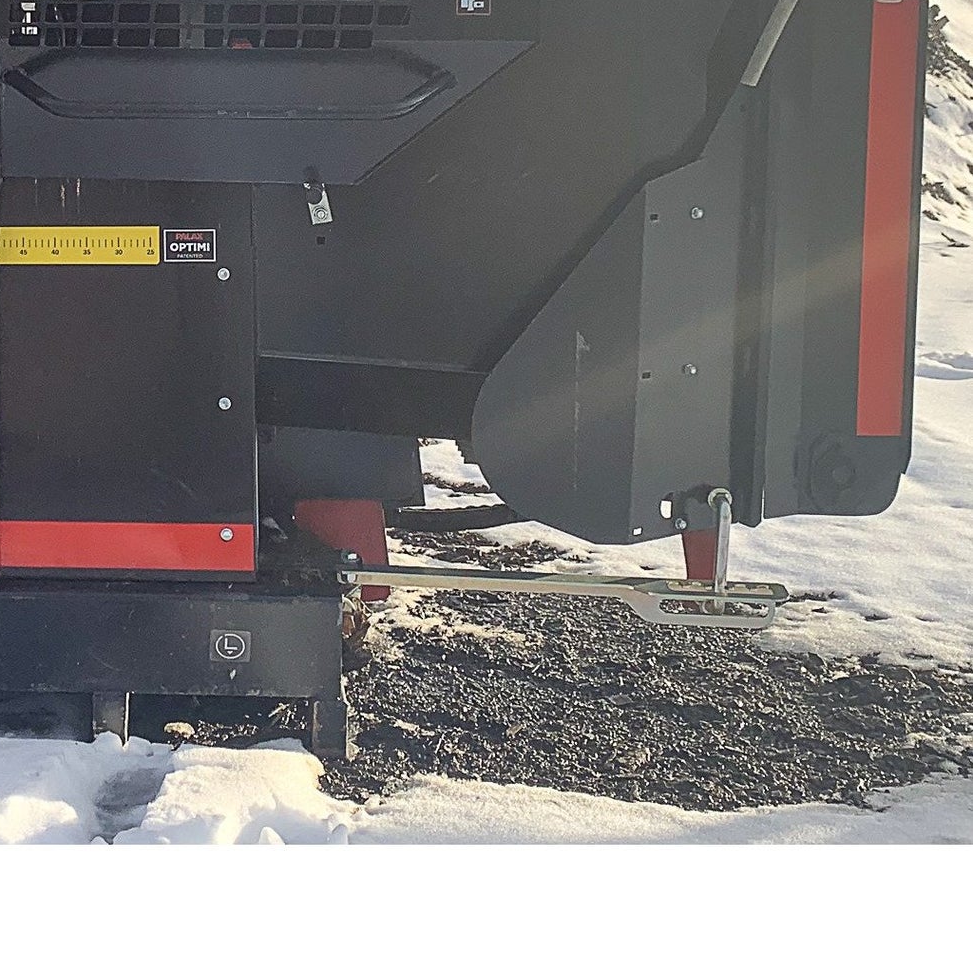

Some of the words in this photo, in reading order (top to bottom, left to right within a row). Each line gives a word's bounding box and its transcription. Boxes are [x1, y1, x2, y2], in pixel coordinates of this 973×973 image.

[175, 232, 204, 241] PALAX
[169, 242, 211, 252] OPTIMI
[19, 248, 28, 256] 45
[50, 248, 60, 256] 40
[82, 248, 91, 256] 35
[114, 248, 123, 256] 30
[146, 248, 155, 256] 25
